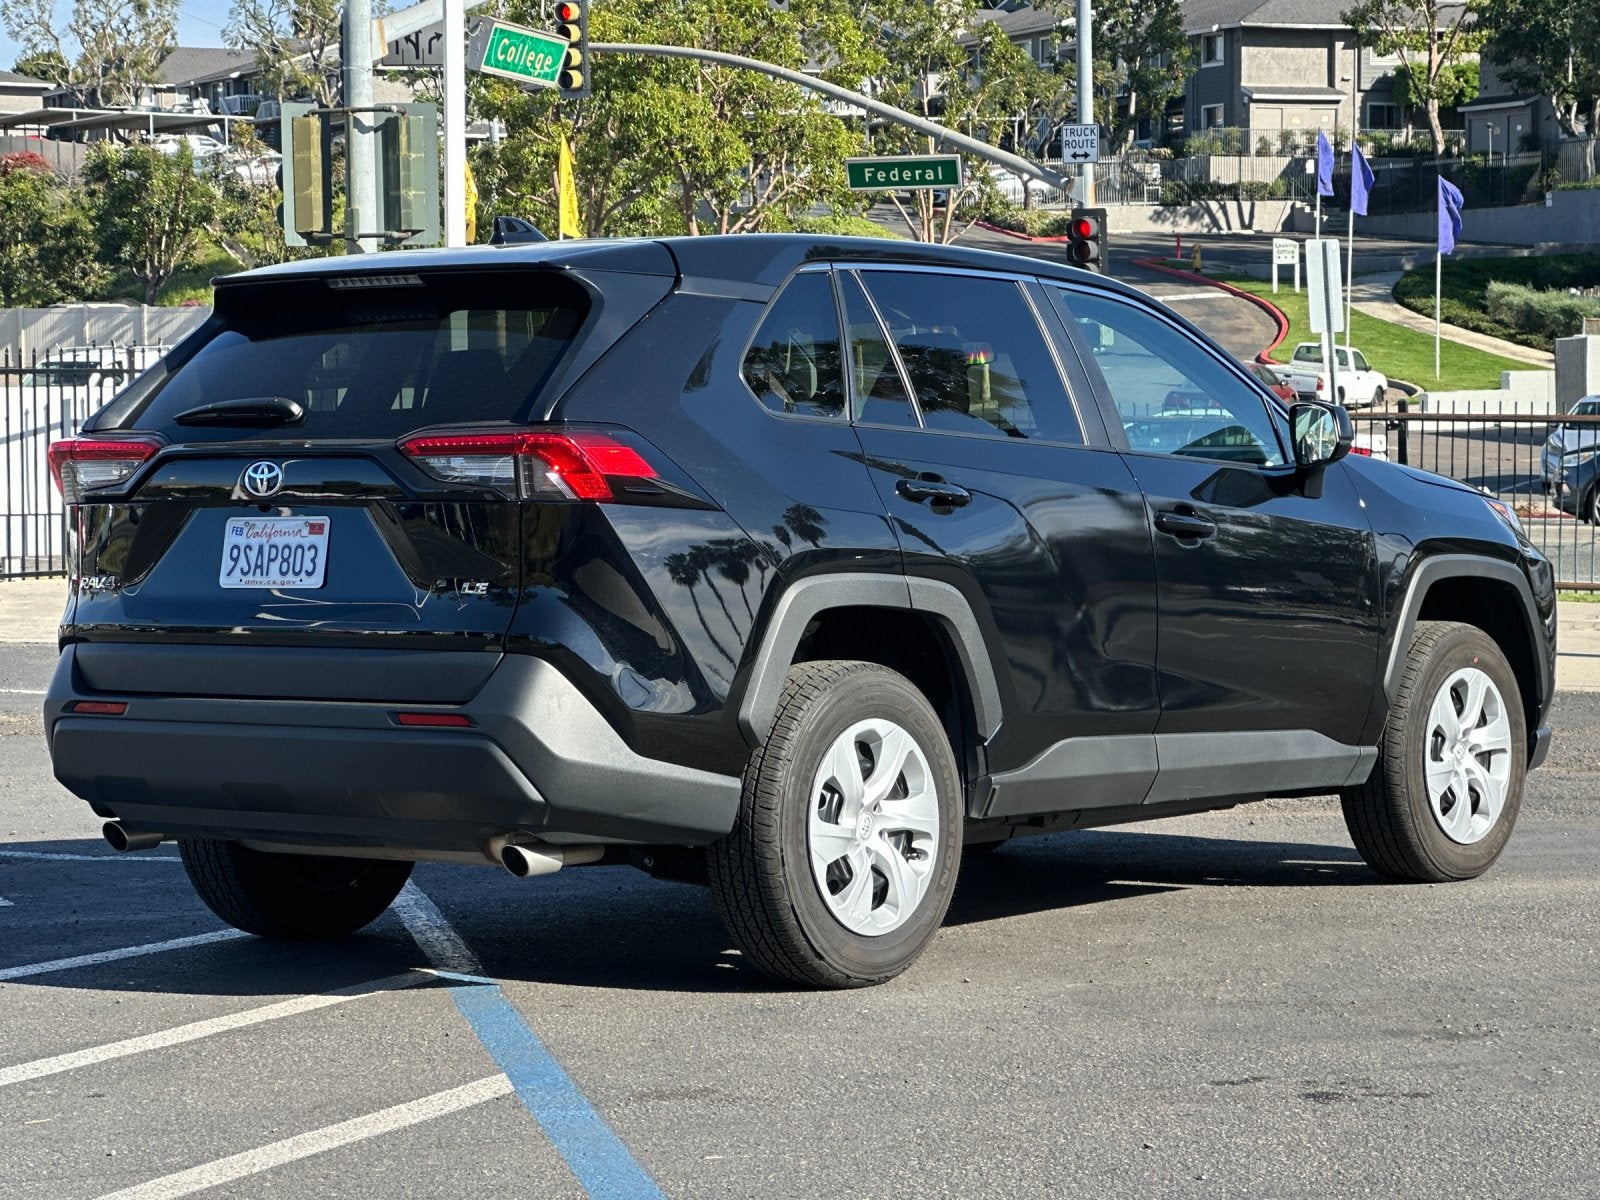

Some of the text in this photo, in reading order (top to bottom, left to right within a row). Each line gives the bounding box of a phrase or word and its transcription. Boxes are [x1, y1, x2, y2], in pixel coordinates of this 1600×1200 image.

[497, 38, 553, 77] College
[1064, 127, 1096, 137] TRUCK
[1065, 139, 1096, 149] ROUTE
[864, 166, 942, 182] Federal
[231, 526, 244, 536] FEB
[246, 523, 308, 543] California
[226, 544, 318, 577] 9SAP803
[80, 575, 116, 589] RAV4
